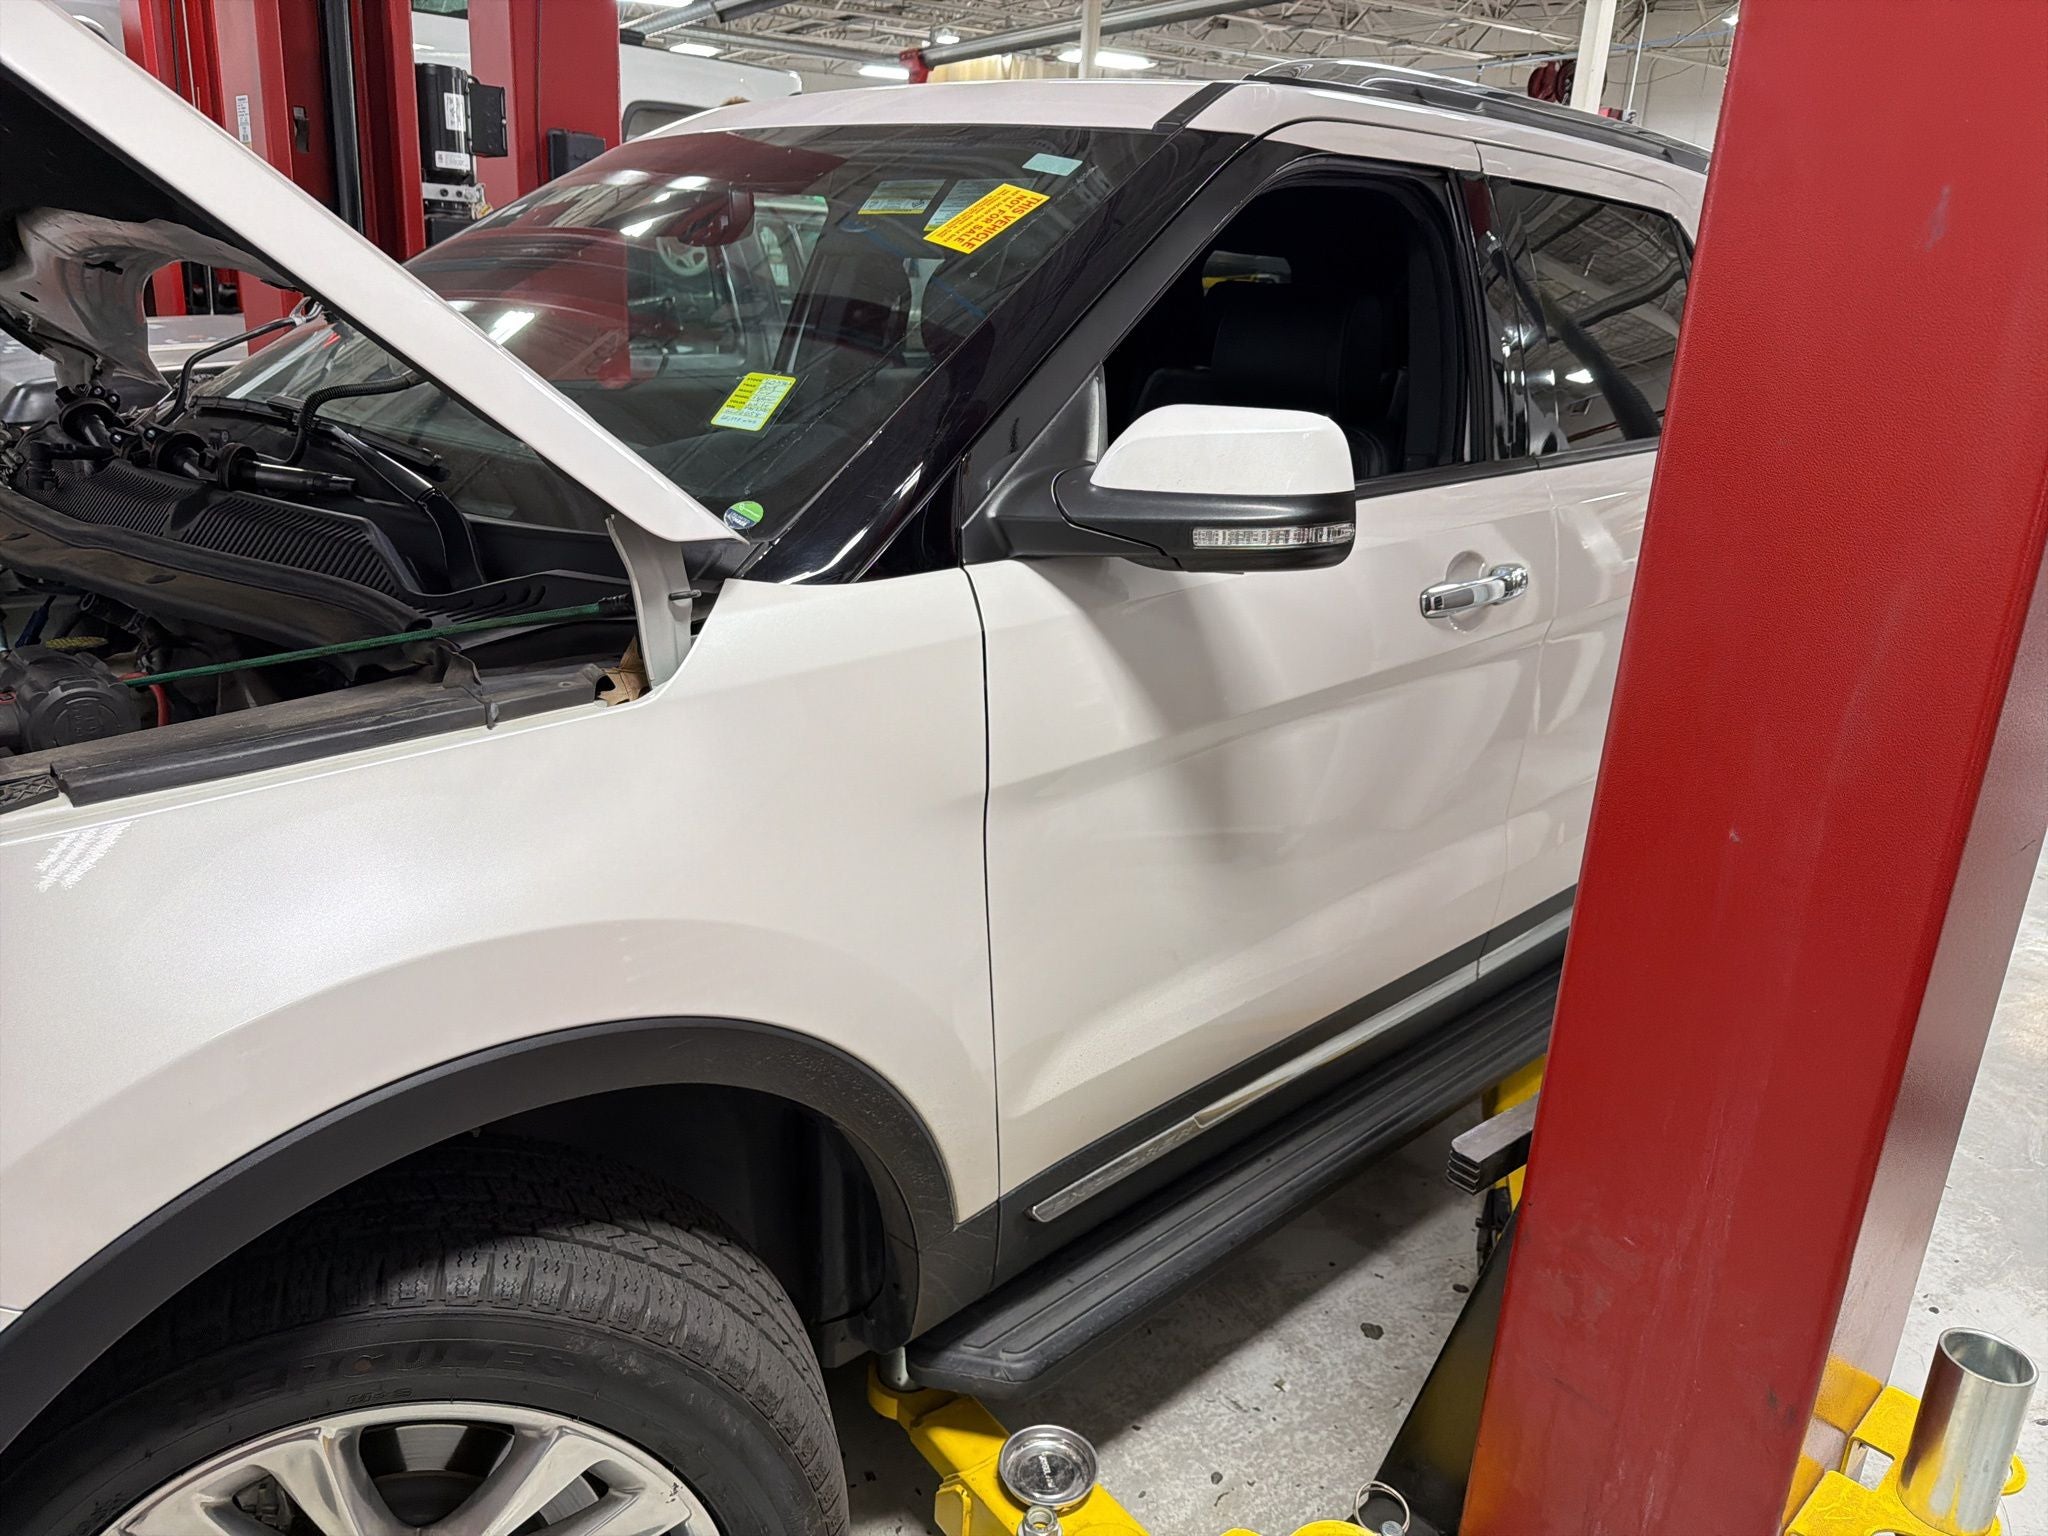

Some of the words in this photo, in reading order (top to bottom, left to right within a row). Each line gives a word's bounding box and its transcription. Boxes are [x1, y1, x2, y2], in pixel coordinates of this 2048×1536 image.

[1002, 194, 1028, 209] NOT
[1009, 195, 1043, 214] THIS
[980, 208, 1007, 224] FOR
[952, 224, 984, 243] SALE
[959, 214, 1016, 249] VEHICLE
